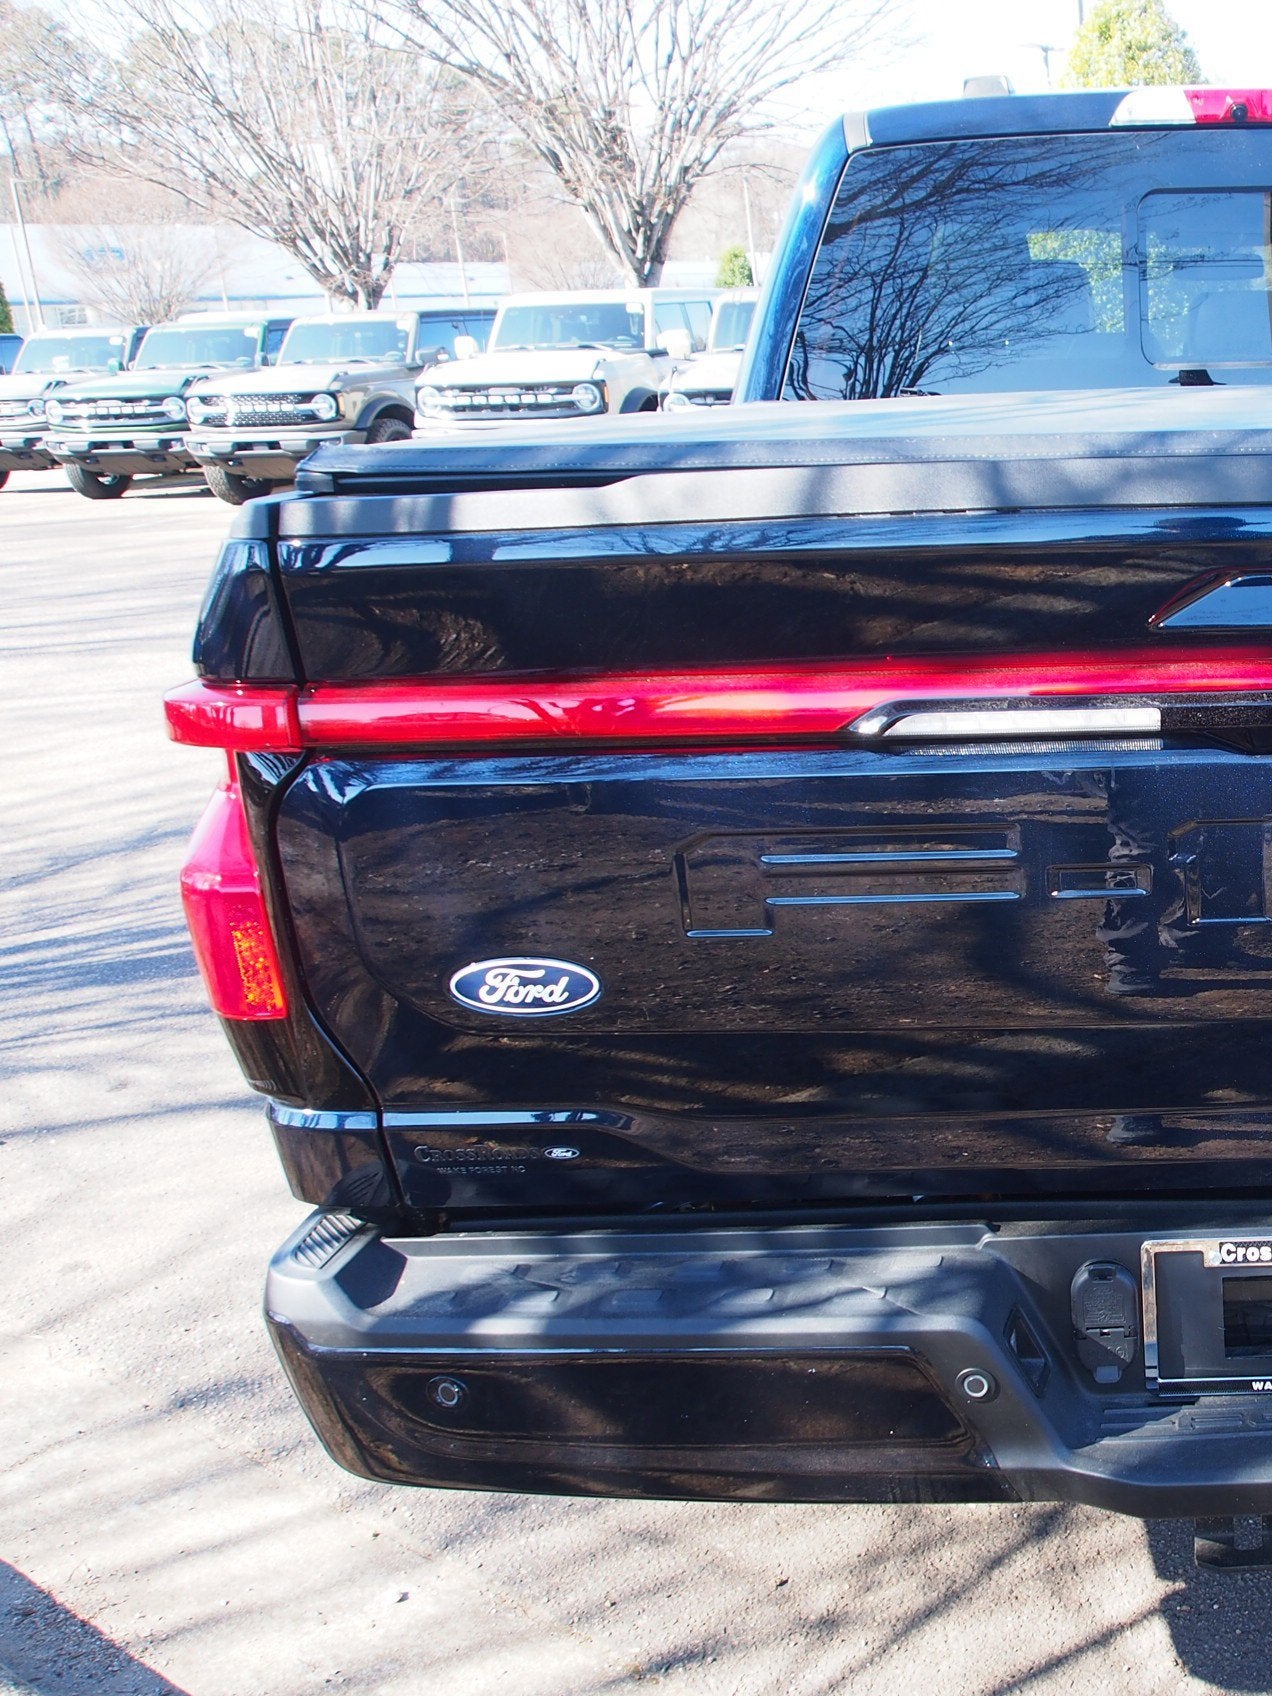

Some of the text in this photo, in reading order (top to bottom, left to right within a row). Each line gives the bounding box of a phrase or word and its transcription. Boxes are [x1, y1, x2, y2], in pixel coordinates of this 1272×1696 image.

[478, 967, 569, 1004] Ford
[437, 1166, 467, 1175] WAKE
[468, 1165, 508, 1175] FOREST
